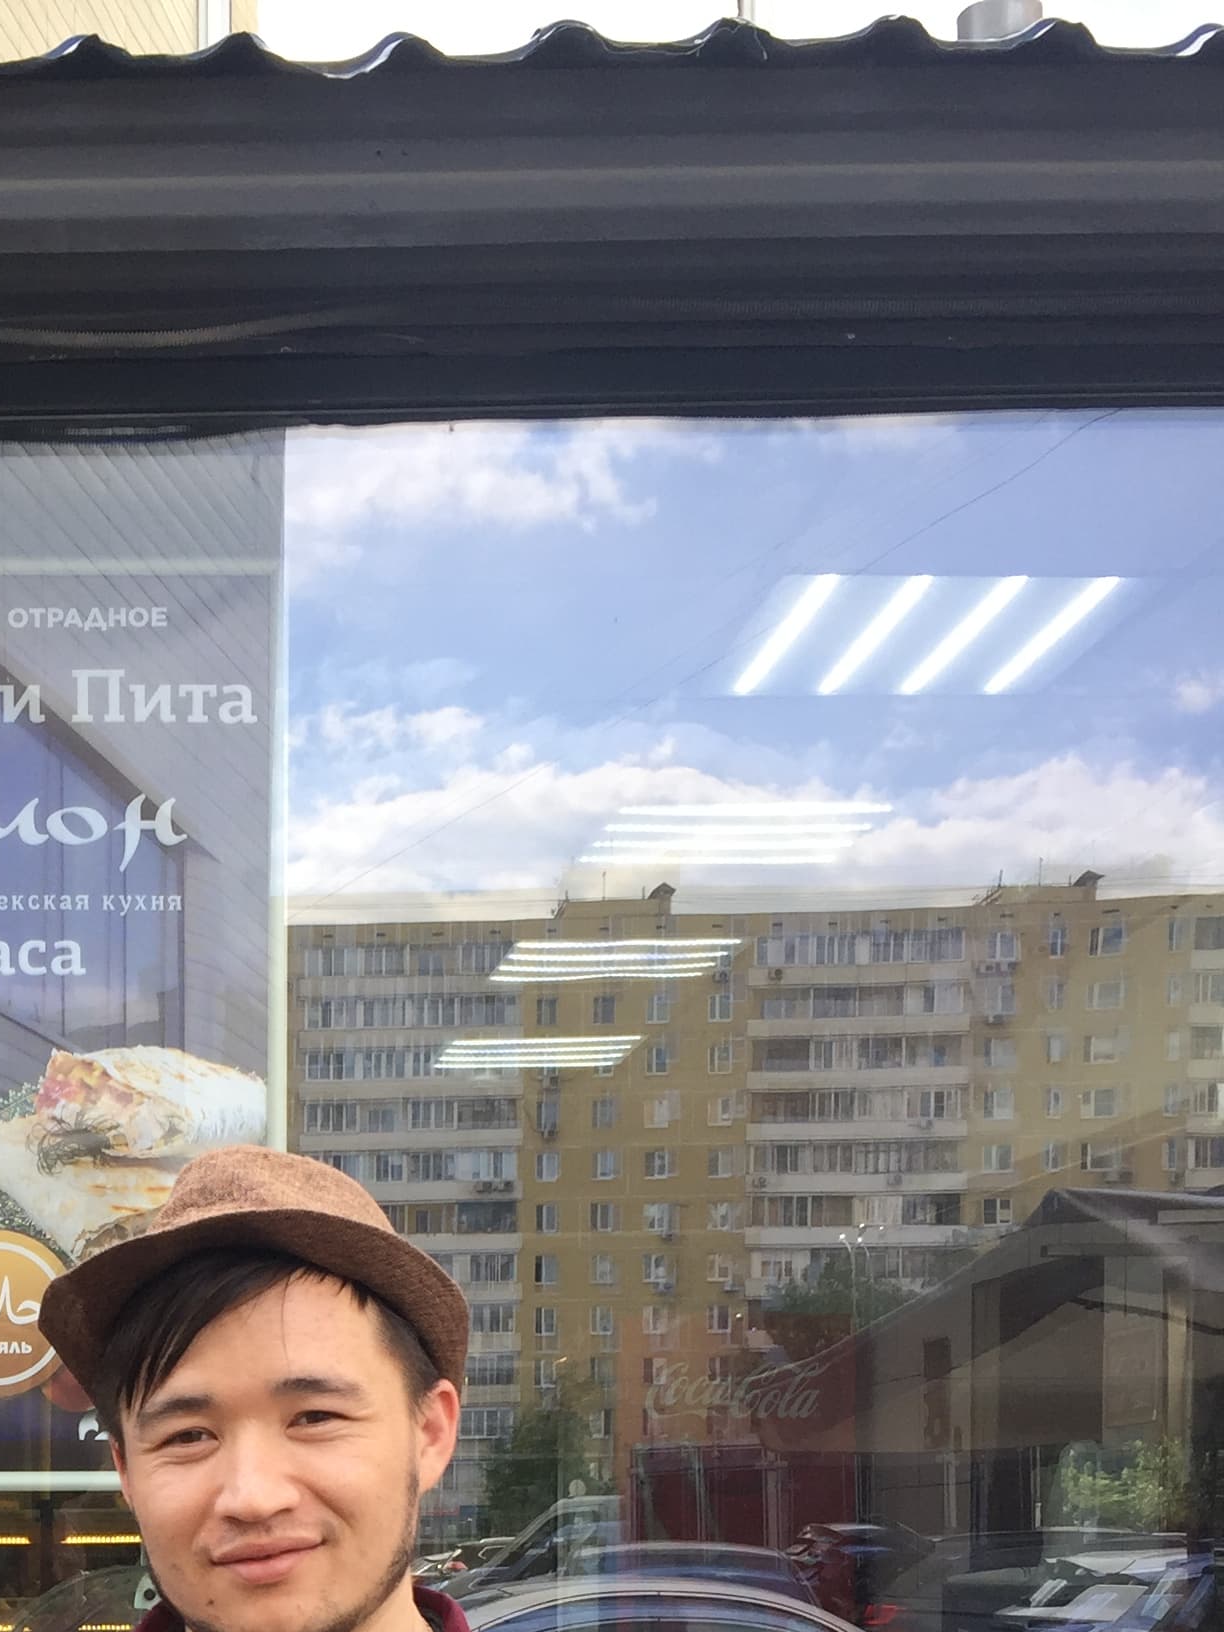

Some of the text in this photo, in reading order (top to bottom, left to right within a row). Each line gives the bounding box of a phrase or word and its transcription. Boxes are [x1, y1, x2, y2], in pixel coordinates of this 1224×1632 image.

[7, 606, 168, 632] ОТРАДНОЕ
[71, 669, 258, 724] Пита
[102, 892, 183, 915] кухня
